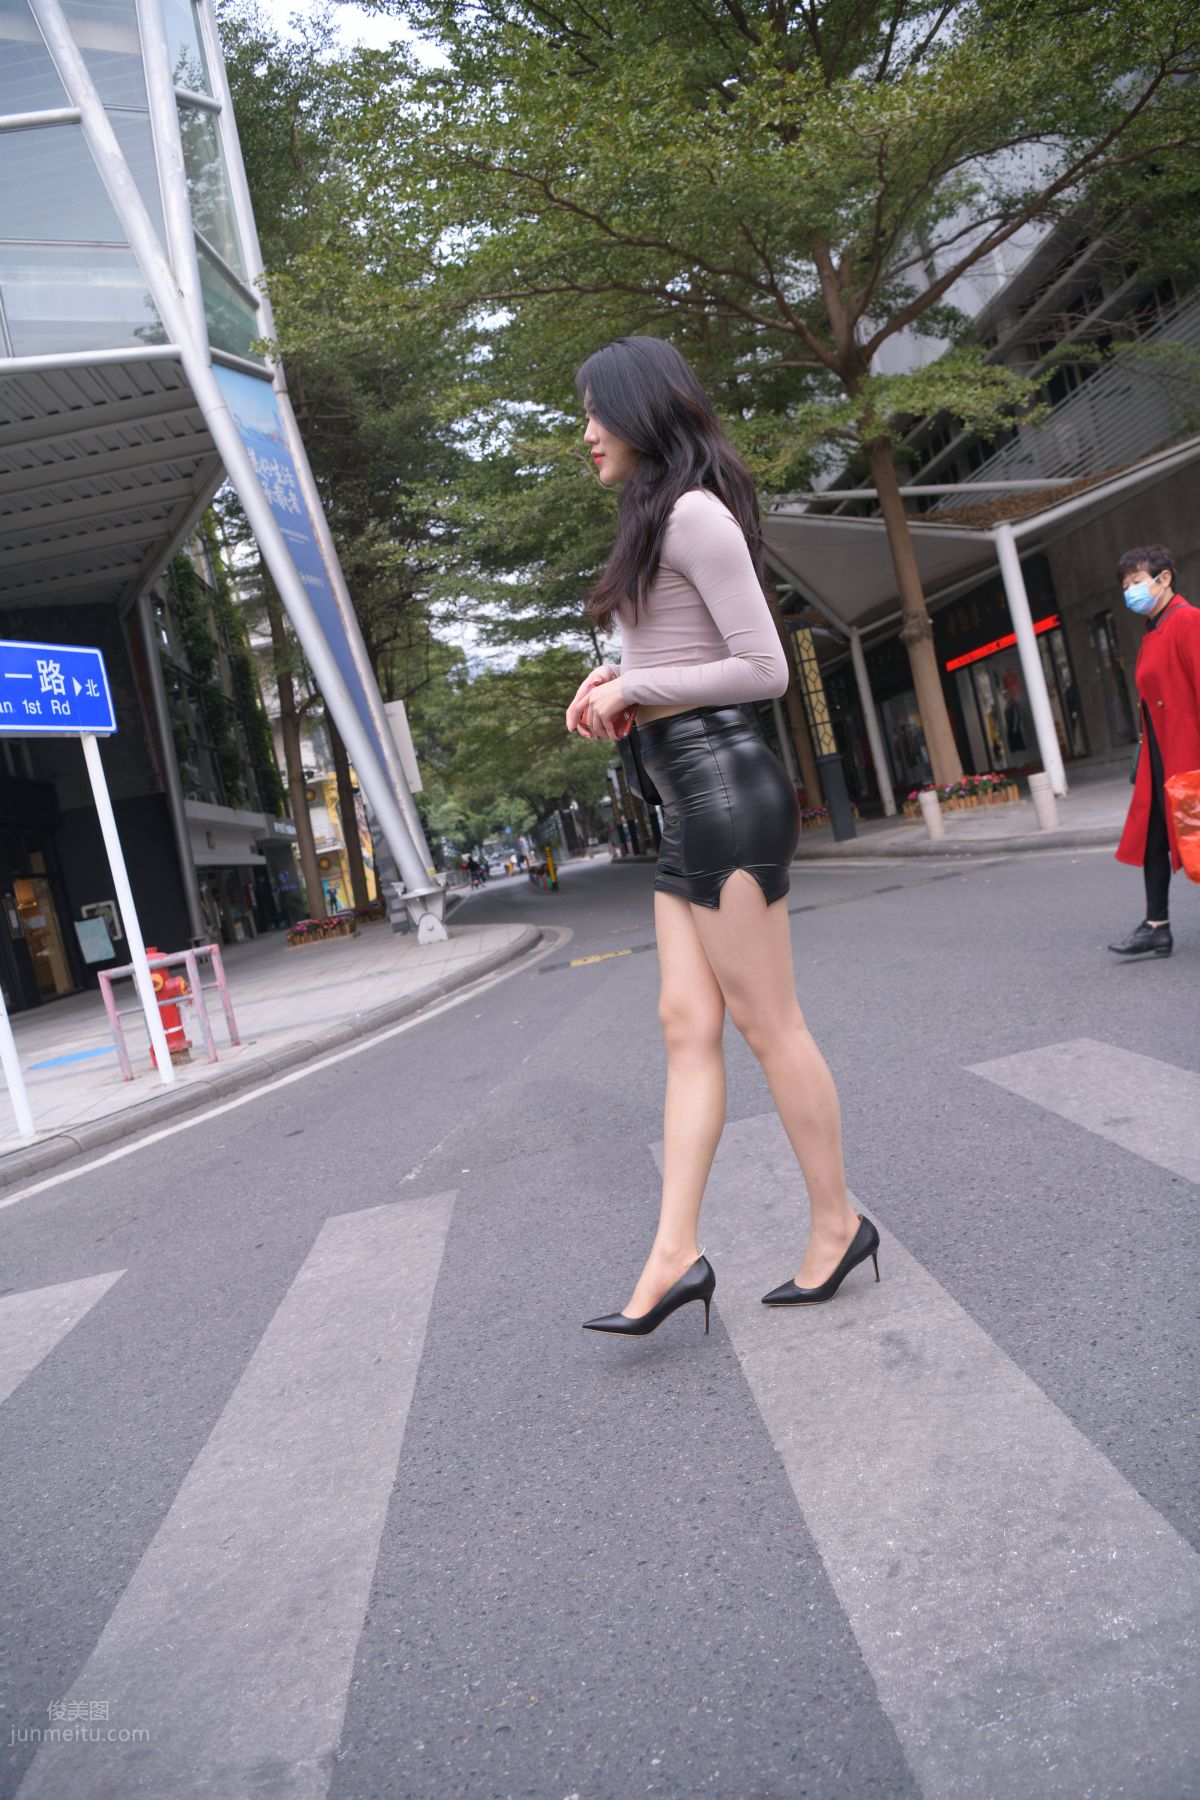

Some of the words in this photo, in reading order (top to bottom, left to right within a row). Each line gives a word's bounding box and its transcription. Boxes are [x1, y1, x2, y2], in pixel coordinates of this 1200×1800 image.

[85, 678, 100, 697] 北
[22, 698, 42, 715] 1st
[50, 699, 71, 715] Rd
